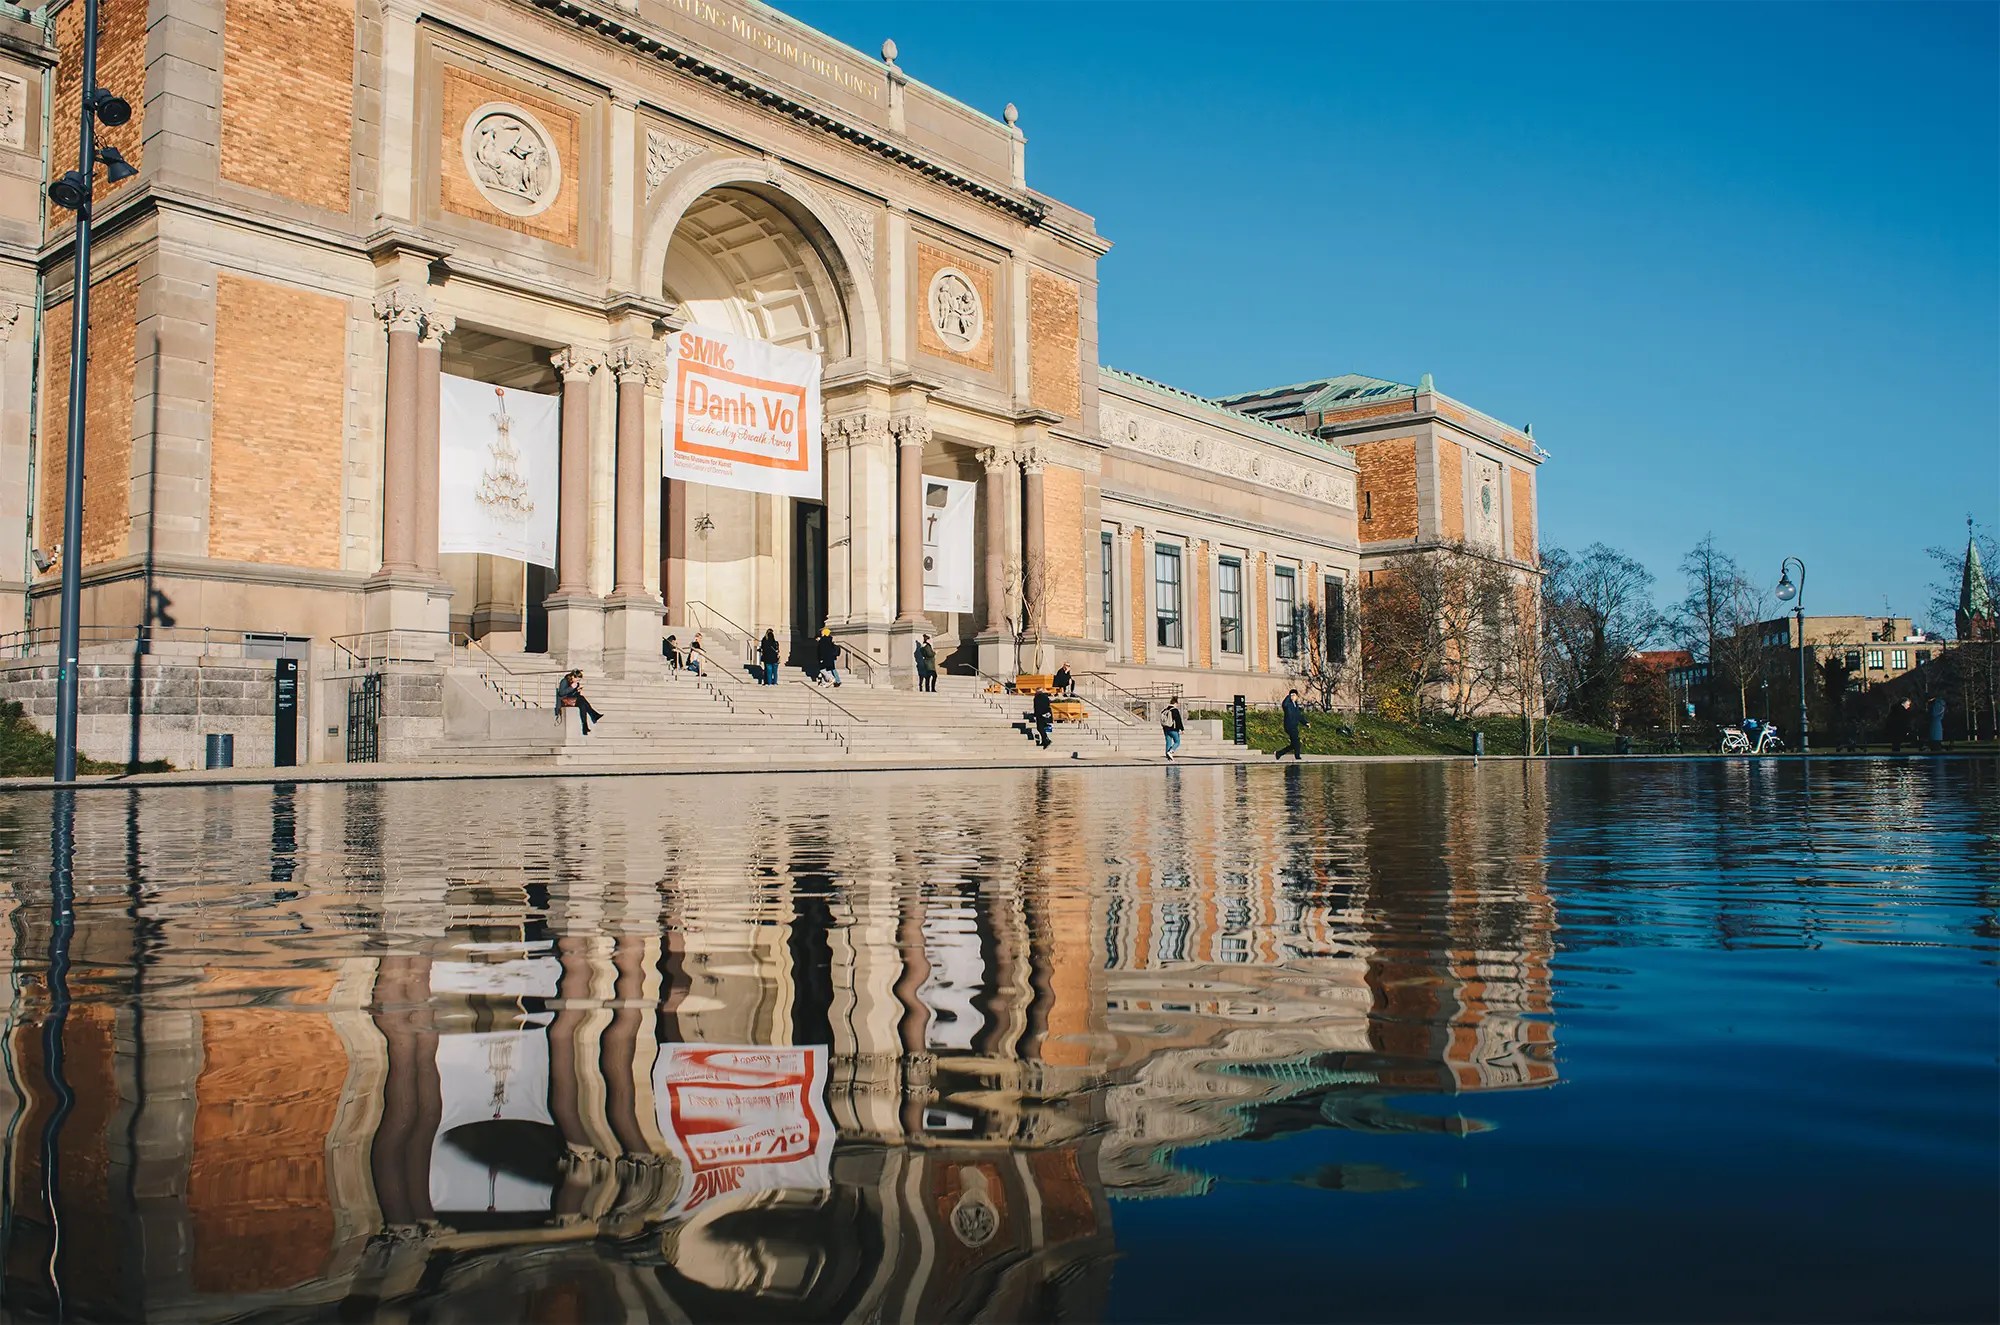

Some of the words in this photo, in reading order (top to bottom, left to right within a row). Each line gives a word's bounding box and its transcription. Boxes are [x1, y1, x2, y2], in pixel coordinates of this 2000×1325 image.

[732, 15, 798, 62] MUSEUM
[803, 52, 830, 78] FOR
[835, 65, 880, 99] KUNST
[679, 333, 728, 369] SMK
[688, 380, 757, 427] Danh
[762, 396, 794, 434] Vo
[688, 417, 714, 435] Take
[716, 426, 737, 444] My
[737, 427, 767, 444] Breath
[769, 434, 792, 454] Away
